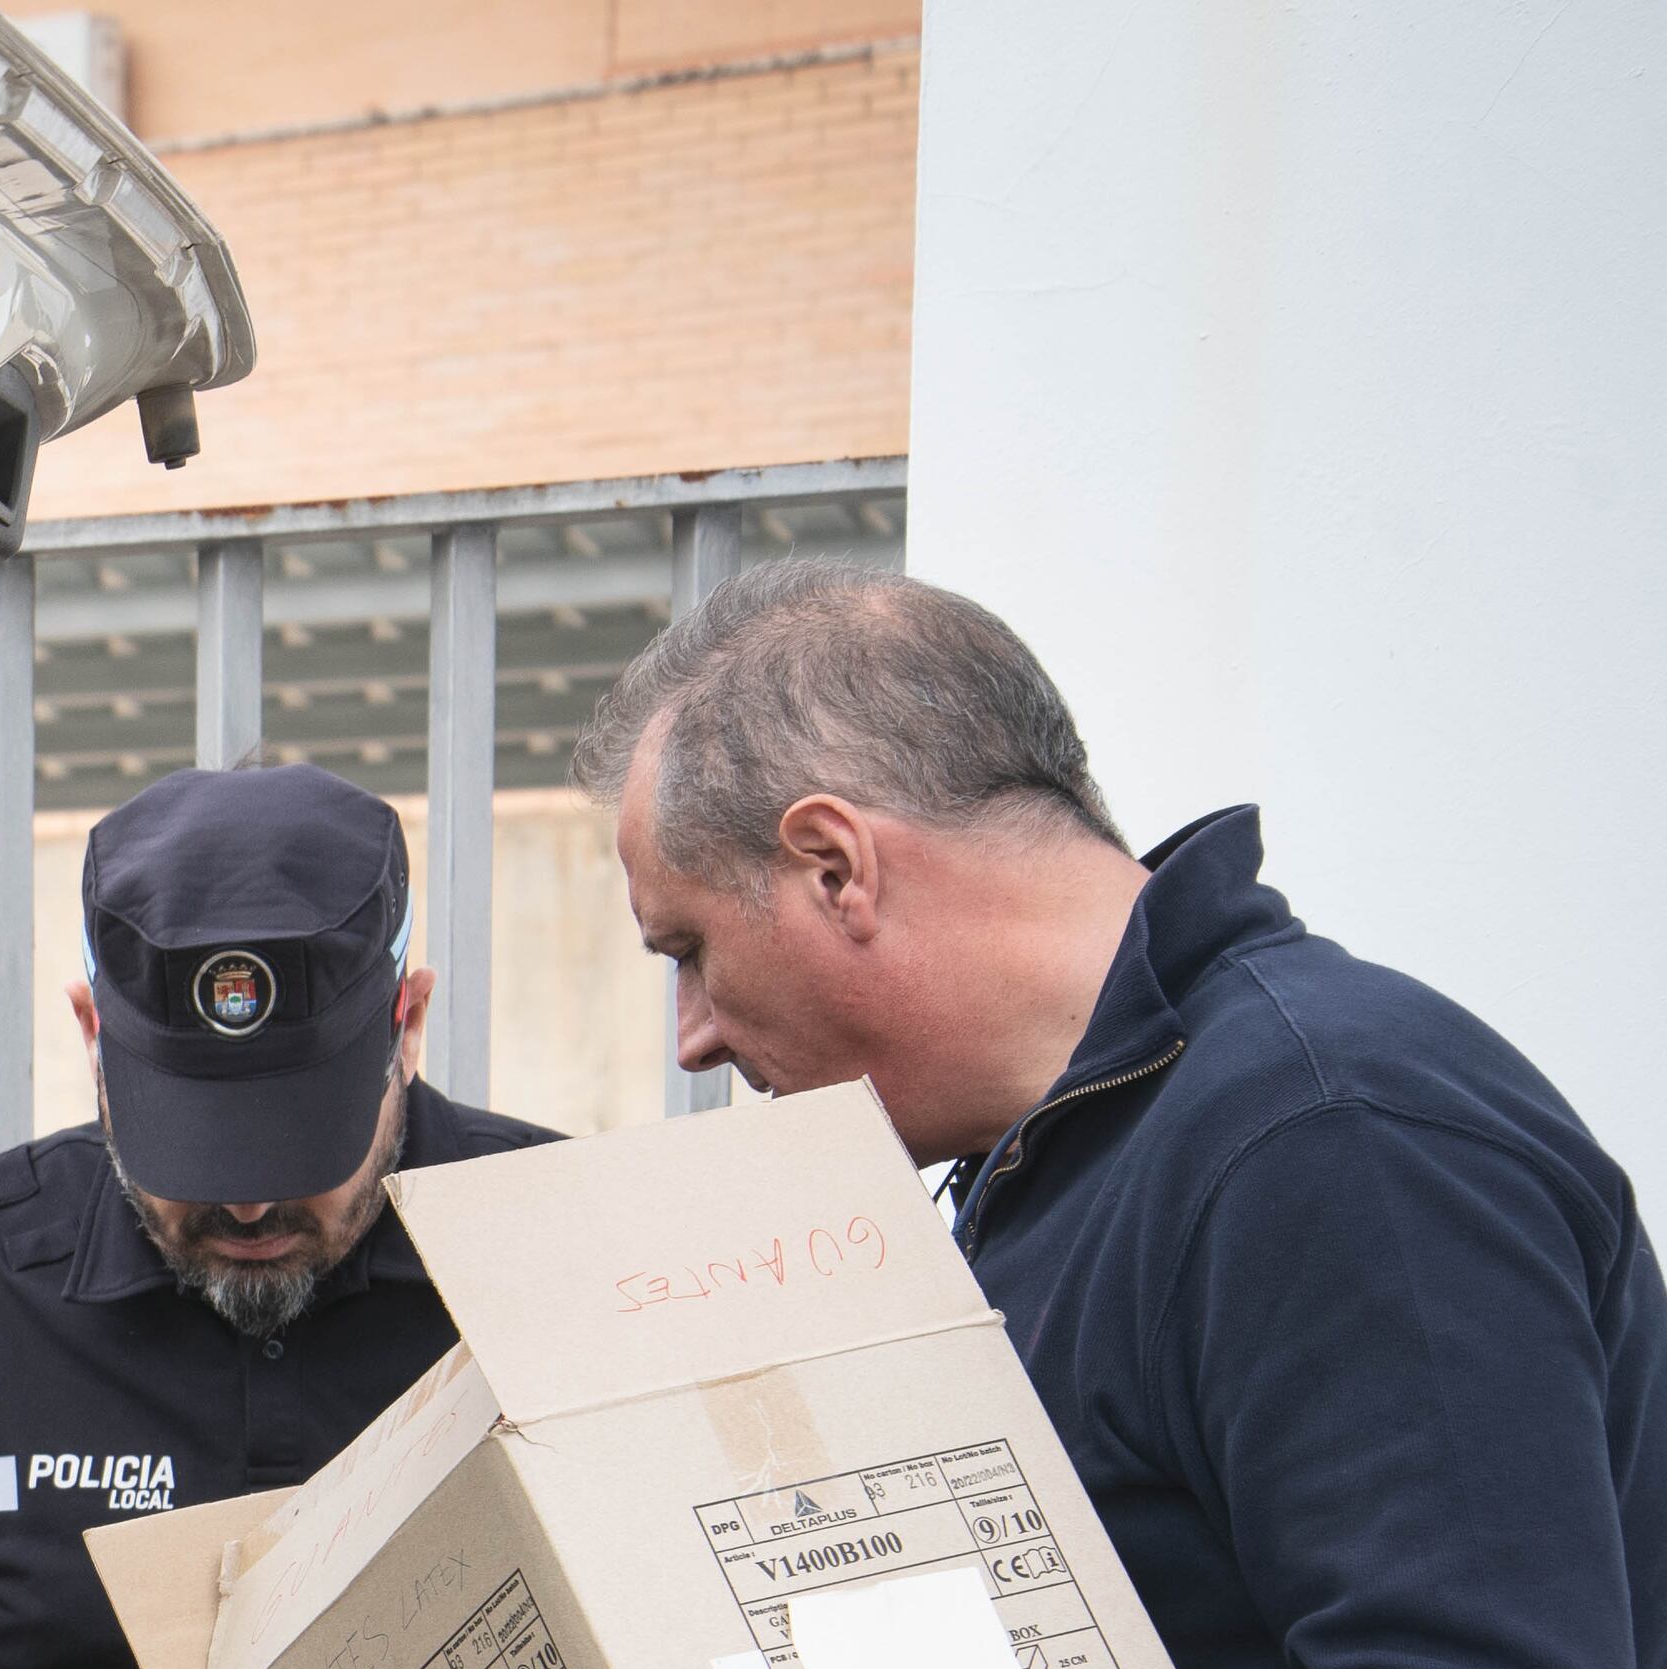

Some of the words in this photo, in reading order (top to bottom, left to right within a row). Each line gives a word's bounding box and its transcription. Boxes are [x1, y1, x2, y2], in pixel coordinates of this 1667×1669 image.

[28, 1454, 174, 1490] POLICIA
[903, 1469, 938, 1491] 216
[109, 1489, 173, 1510] LOCAL
[710, 1520, 741, 1535] DPG
[769, 1508, 858, 1535] DELTAPLUS
[754, 1531, 905, 1583] V1400B100
[471, 1627, 493, 1658] 216
[1008, 1624, 1042, 1641] BOX
[1058, 1658, 1071, 1668] 25
[1069, 1654, 1088, 1665] CM
